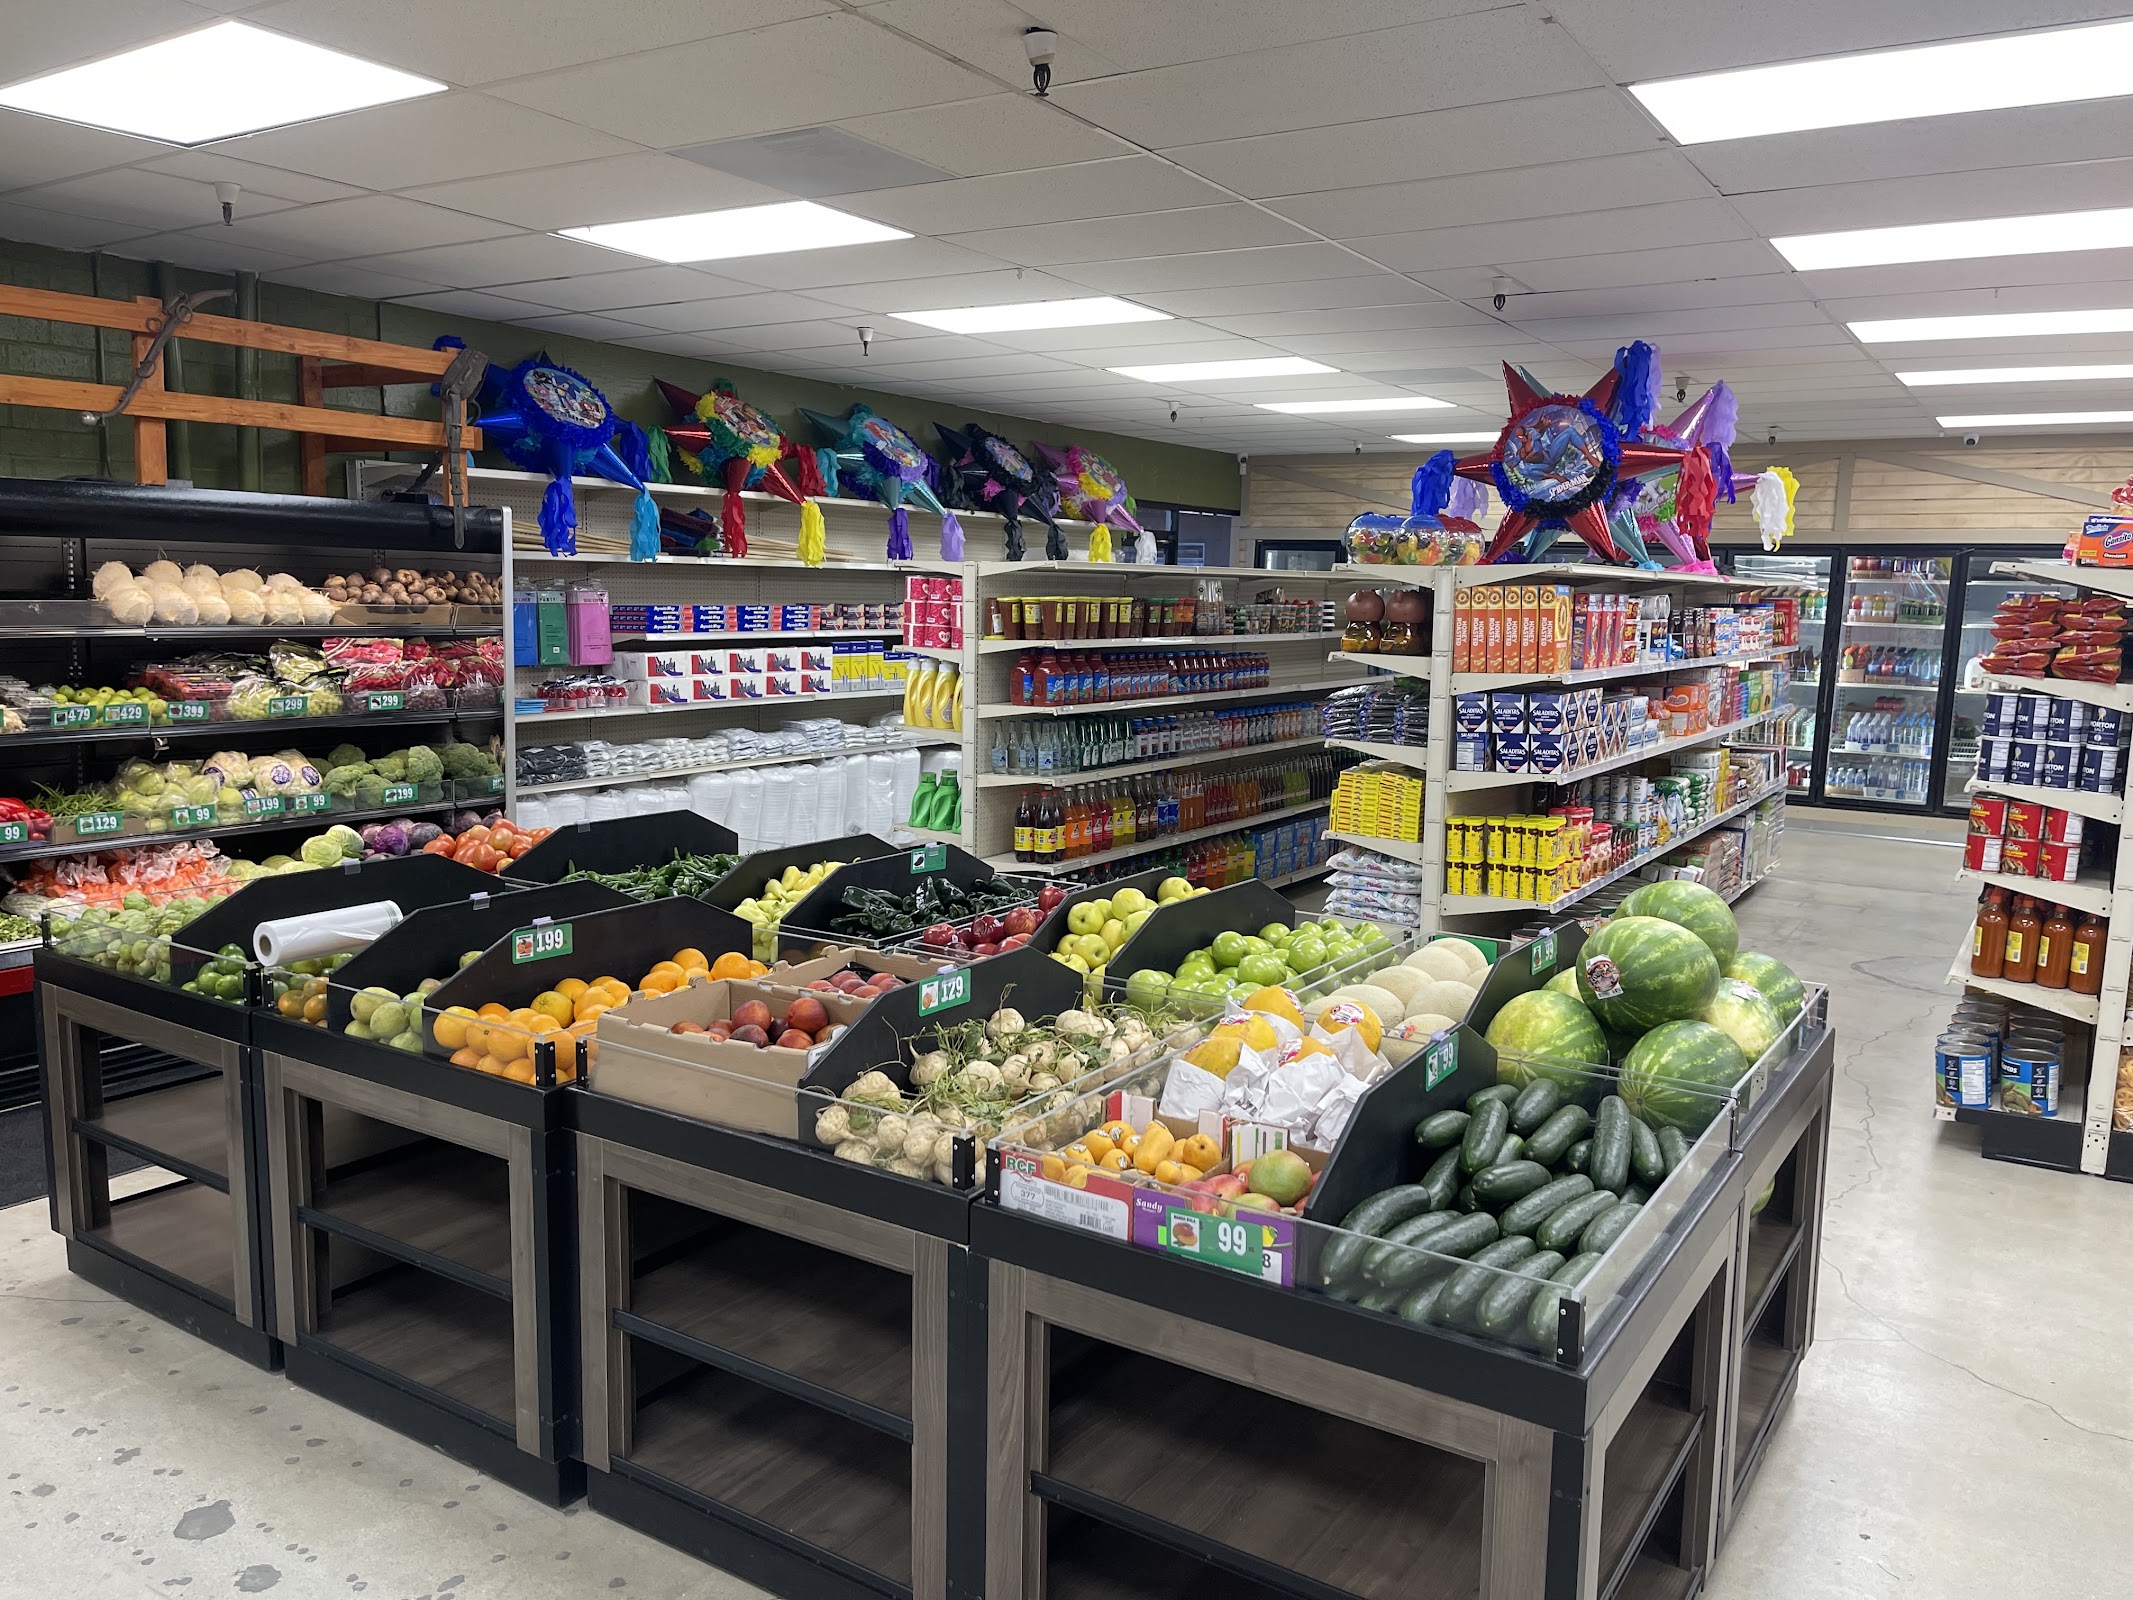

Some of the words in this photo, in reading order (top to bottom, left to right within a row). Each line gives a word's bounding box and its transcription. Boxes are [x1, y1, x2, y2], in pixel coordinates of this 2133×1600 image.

[2105, 532, 2132, 548] Gansito
[285, 698, 303, 711] 299
[382, 695, 399, 707] 299
[68, 707, 91, 721] 479
[120, 707, 142, 720] 429
[183, 705, 204, 718] 399
[1494, 708, 1520, 716] SALADITAS
[1533, 709, 1559, 717] SALADITAS
[1499, 748, 1526, 756] SALADITAS
[1533, 748, 1560, 757] SALADITAS
[397, 788, 414, 800] 199
[261, 798, 279, 811] 199
[313, 795, 326, 807] 99
[196, 808, 210, 821] 99
[95, 816, 118, 831] 129
[4, 826, 21, 840] 99
[536, 928, 564, 952] 199
[941, 975, 964, 1002] 129
[1005, 1156, 1036, 1175] RCF
[1020, 1190, 1036, 1200] 377
[1135, 1198, 1163, 1213] Sandy
[1218, 1222, 1247, 1257] 99
